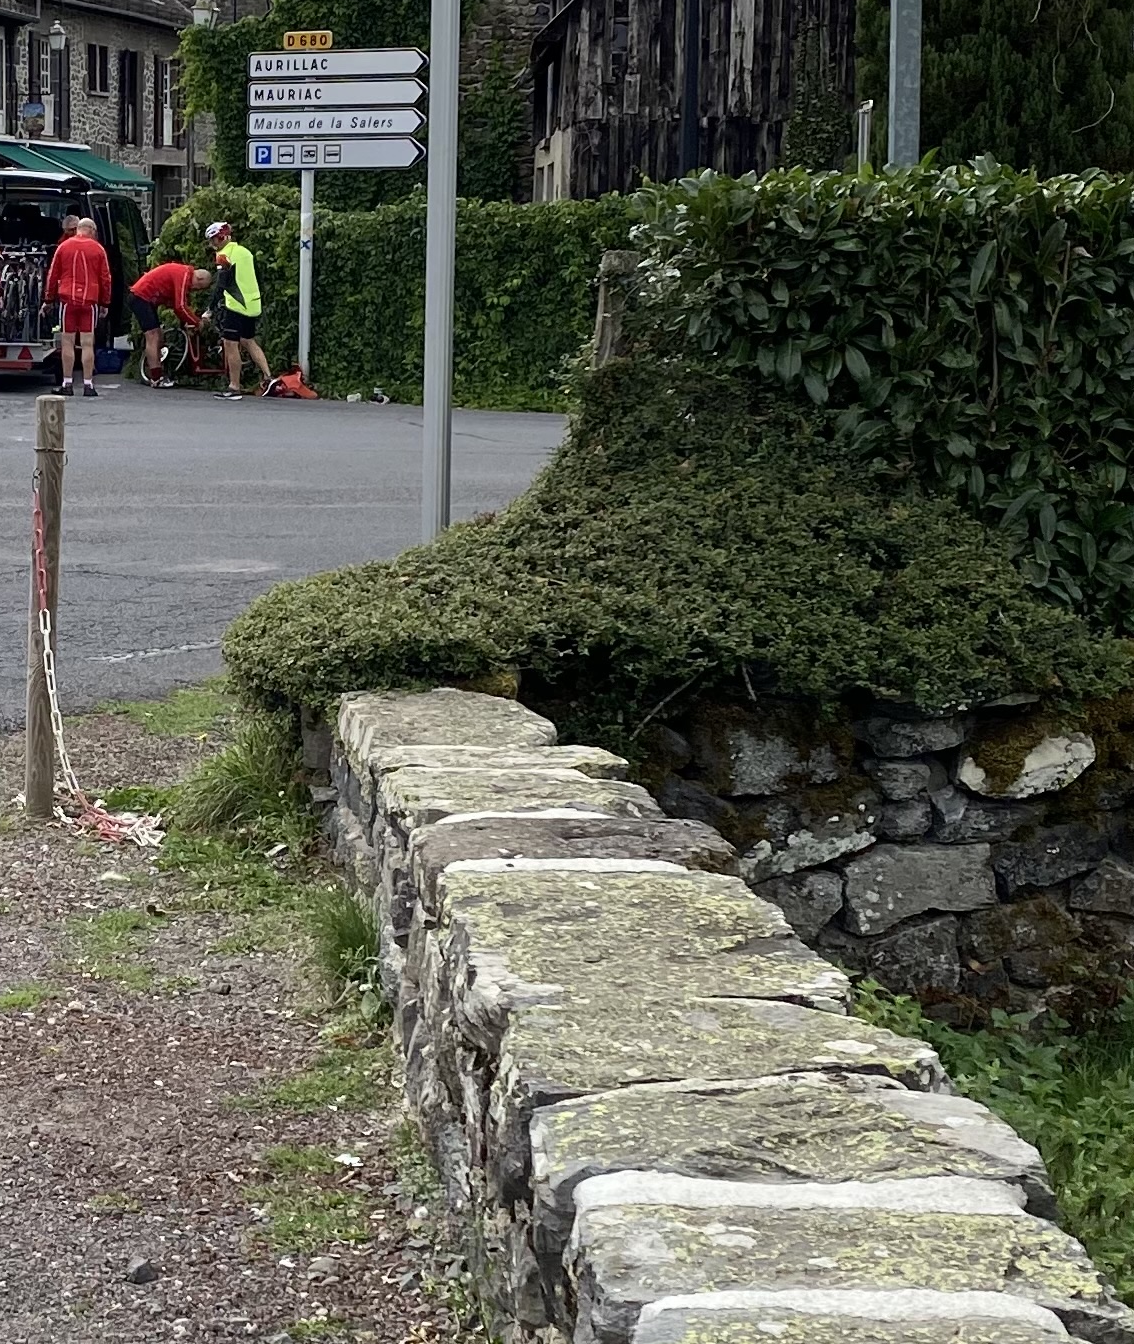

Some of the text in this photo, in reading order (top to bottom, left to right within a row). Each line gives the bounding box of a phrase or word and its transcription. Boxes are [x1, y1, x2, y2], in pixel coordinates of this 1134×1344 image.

[287, 34, 328, 47] D 680
[254, 58, 329, 72] AURILLAC
[254, 88, 323, 102] MAURIAC
[253, 115, 394, 130] Maison de la Salers
[258, 147, 269, 163] P
